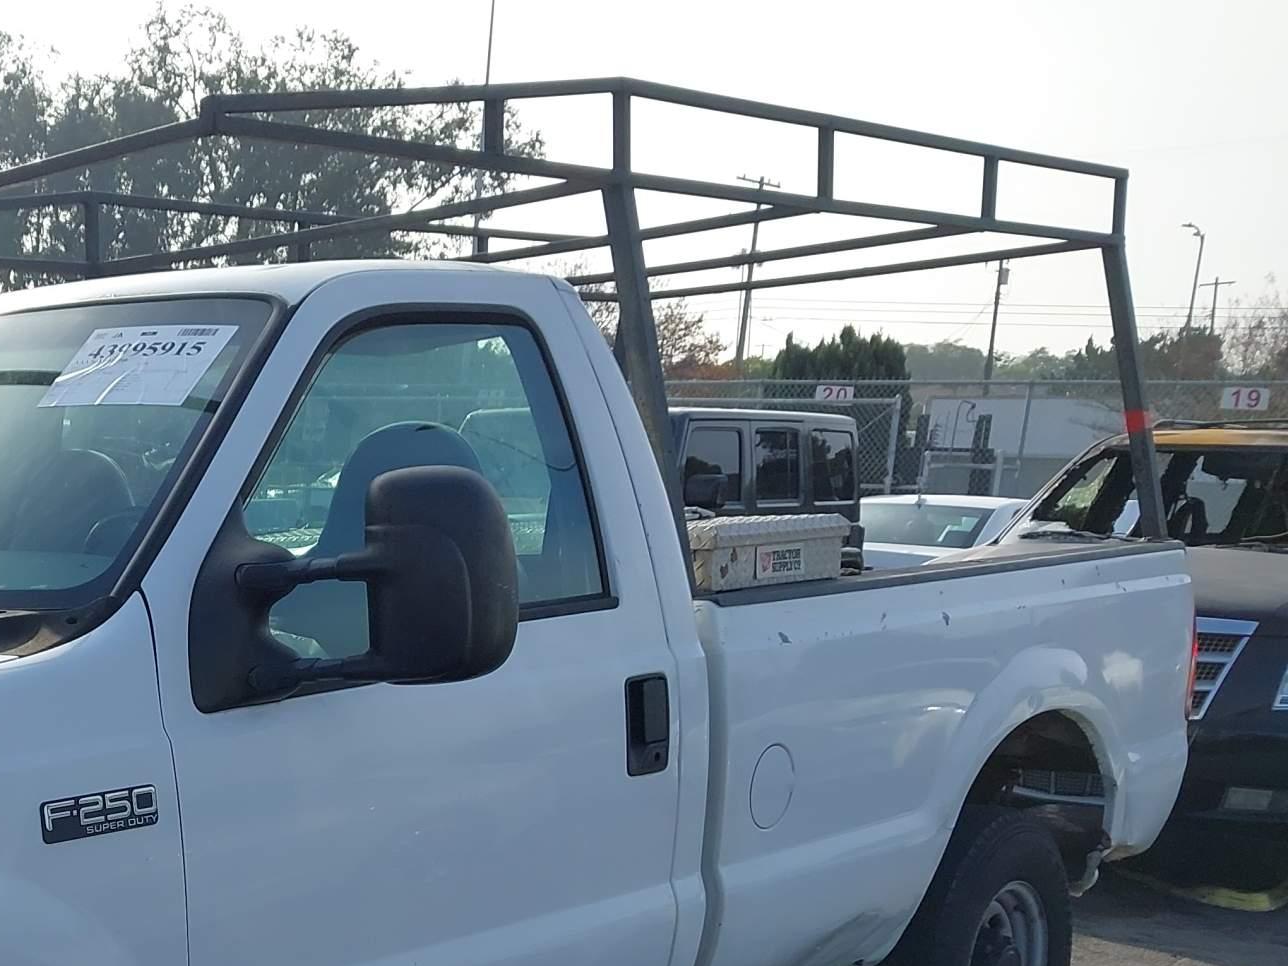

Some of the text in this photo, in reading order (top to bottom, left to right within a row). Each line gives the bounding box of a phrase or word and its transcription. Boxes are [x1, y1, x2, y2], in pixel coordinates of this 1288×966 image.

[823, 386, 848, 400] 20
[1231, 389, 1261, 408] 19
[772, 548, 801, 561] TRACTOR
[772, 560, 792, 572] SUPPLY
[43, 786, 158, 832] F-250
[86, 814, 158, 834] SUPER DUTY
